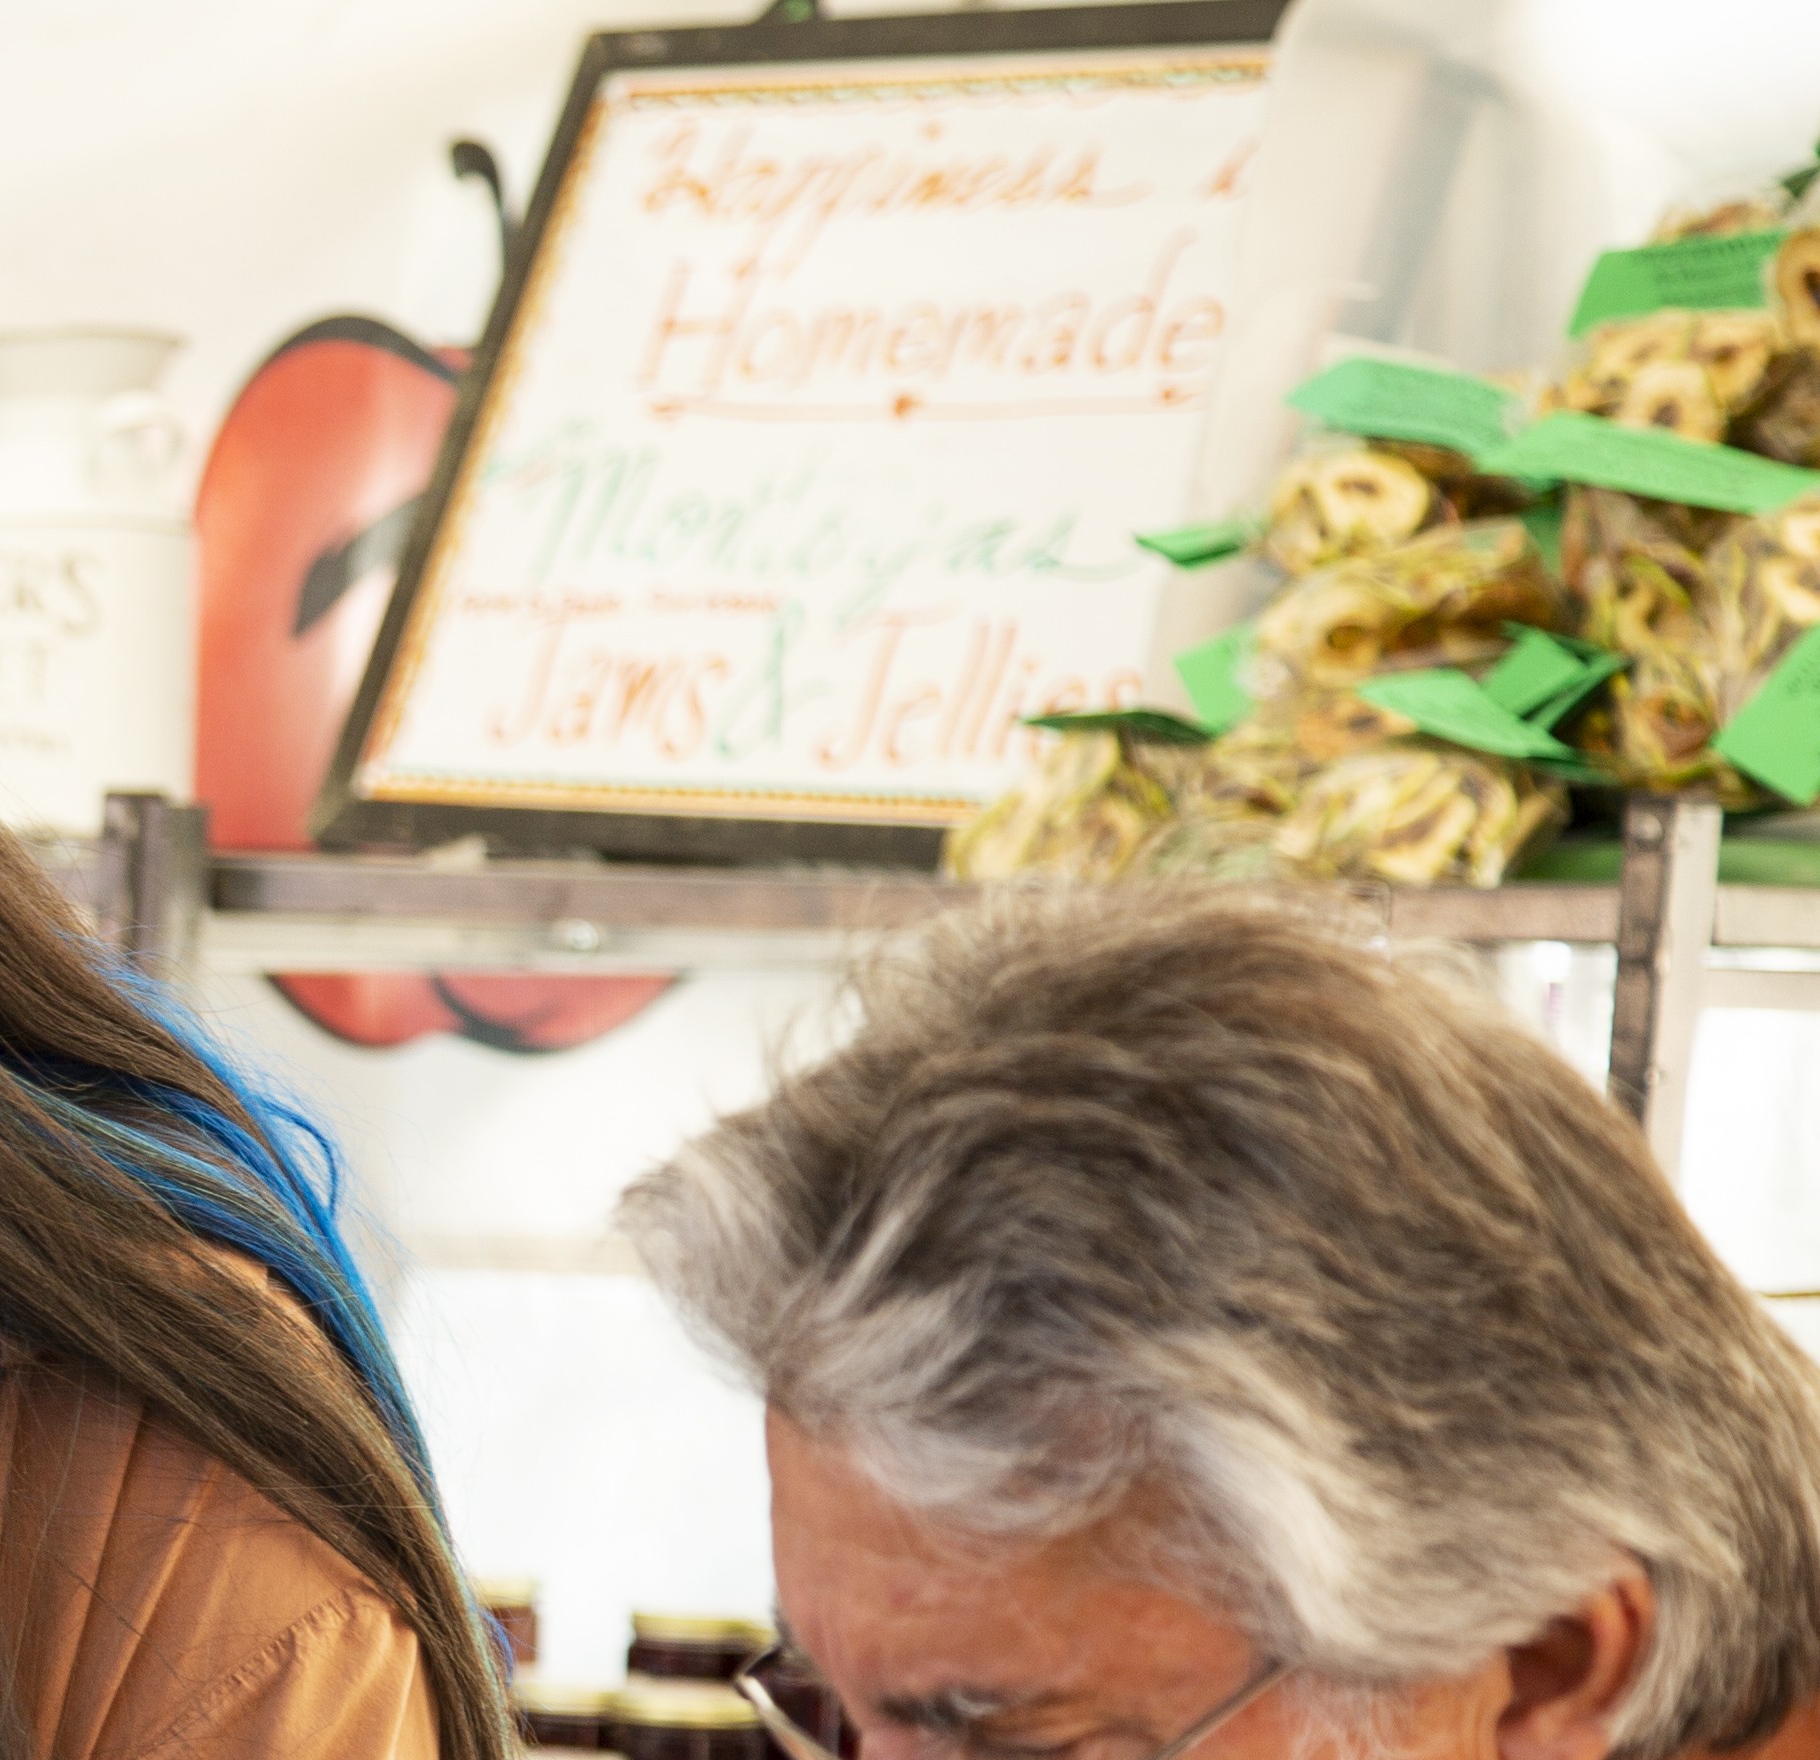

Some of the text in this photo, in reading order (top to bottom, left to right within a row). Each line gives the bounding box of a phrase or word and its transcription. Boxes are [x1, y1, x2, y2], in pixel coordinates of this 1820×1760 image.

[635, 112, 1157, 282] Happiness
[635, 225, 1227, 394] Homemade
[483, 612, 732, 765] Jams
[711, 600, 831, 763] &
